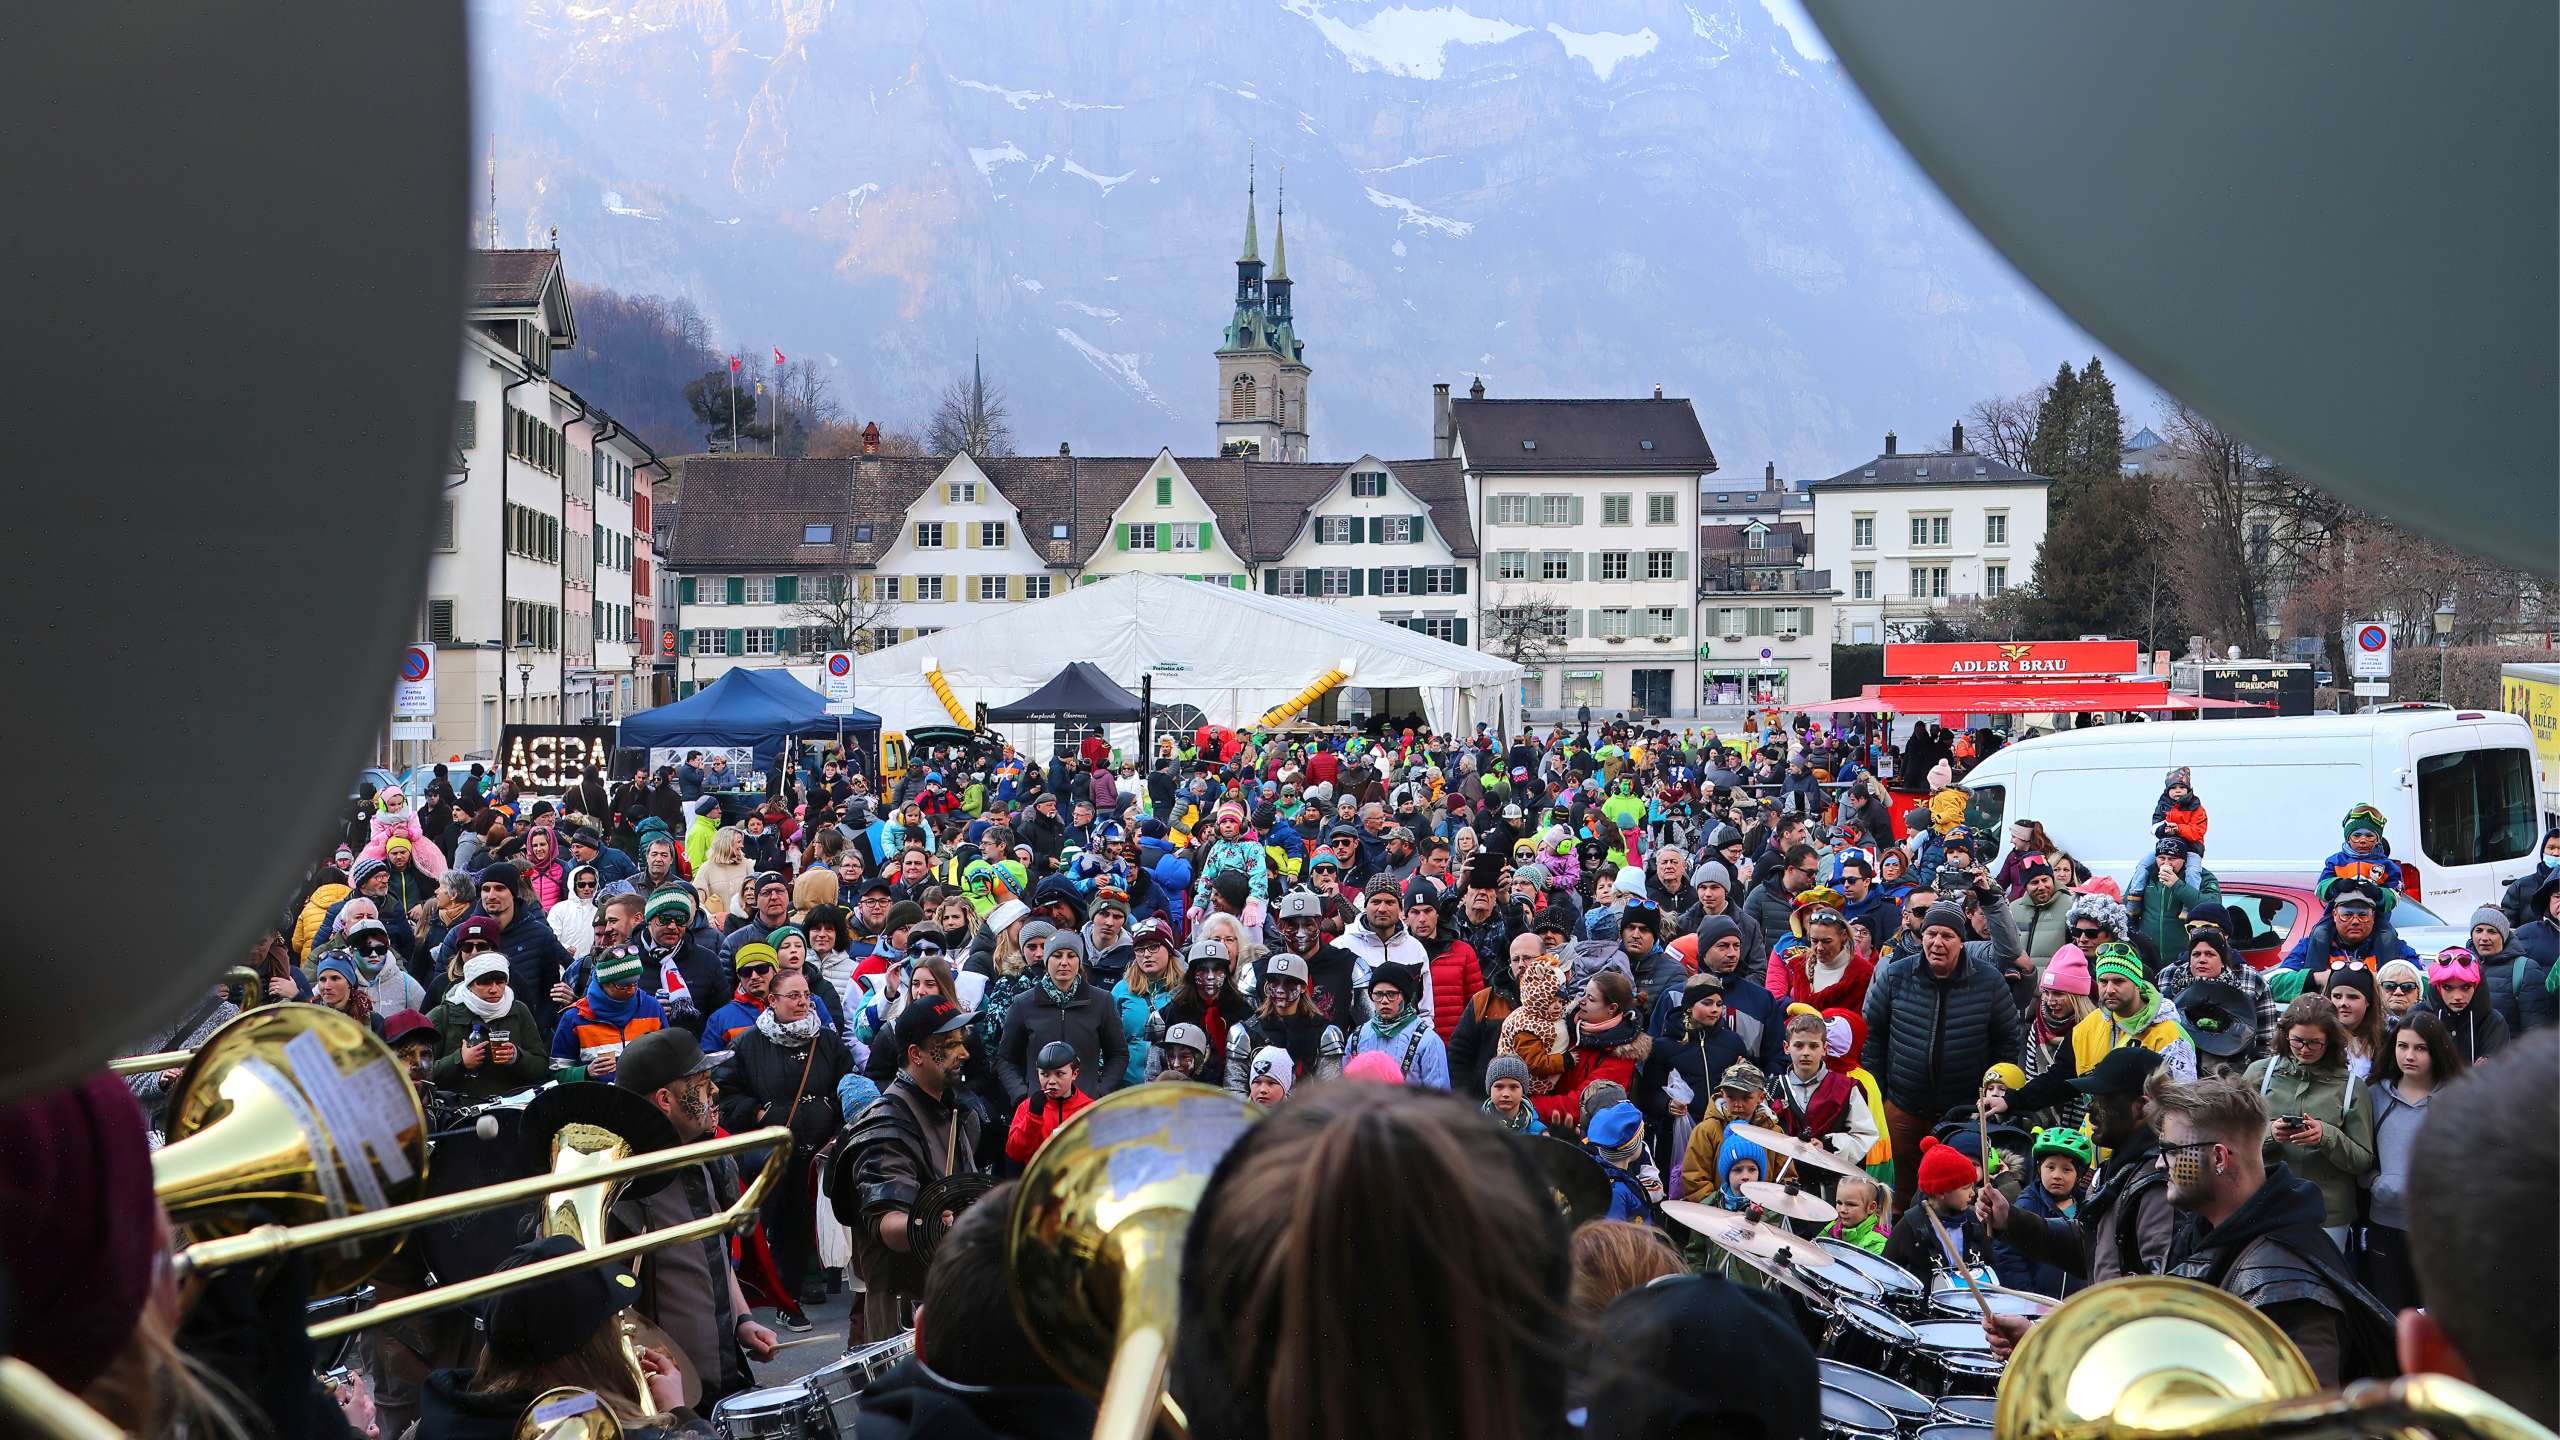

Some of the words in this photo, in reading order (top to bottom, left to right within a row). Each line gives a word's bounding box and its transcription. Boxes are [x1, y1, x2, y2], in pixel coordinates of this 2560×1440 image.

[1951, 660, 2010, 672] ADLER
[2019, 659, 2067, 671] BRÄU
[2271, 669, 2289, 678] KICK
[2533, 713, 2558, 730] ADLER
[506, 735, 607, 787] ABBA
